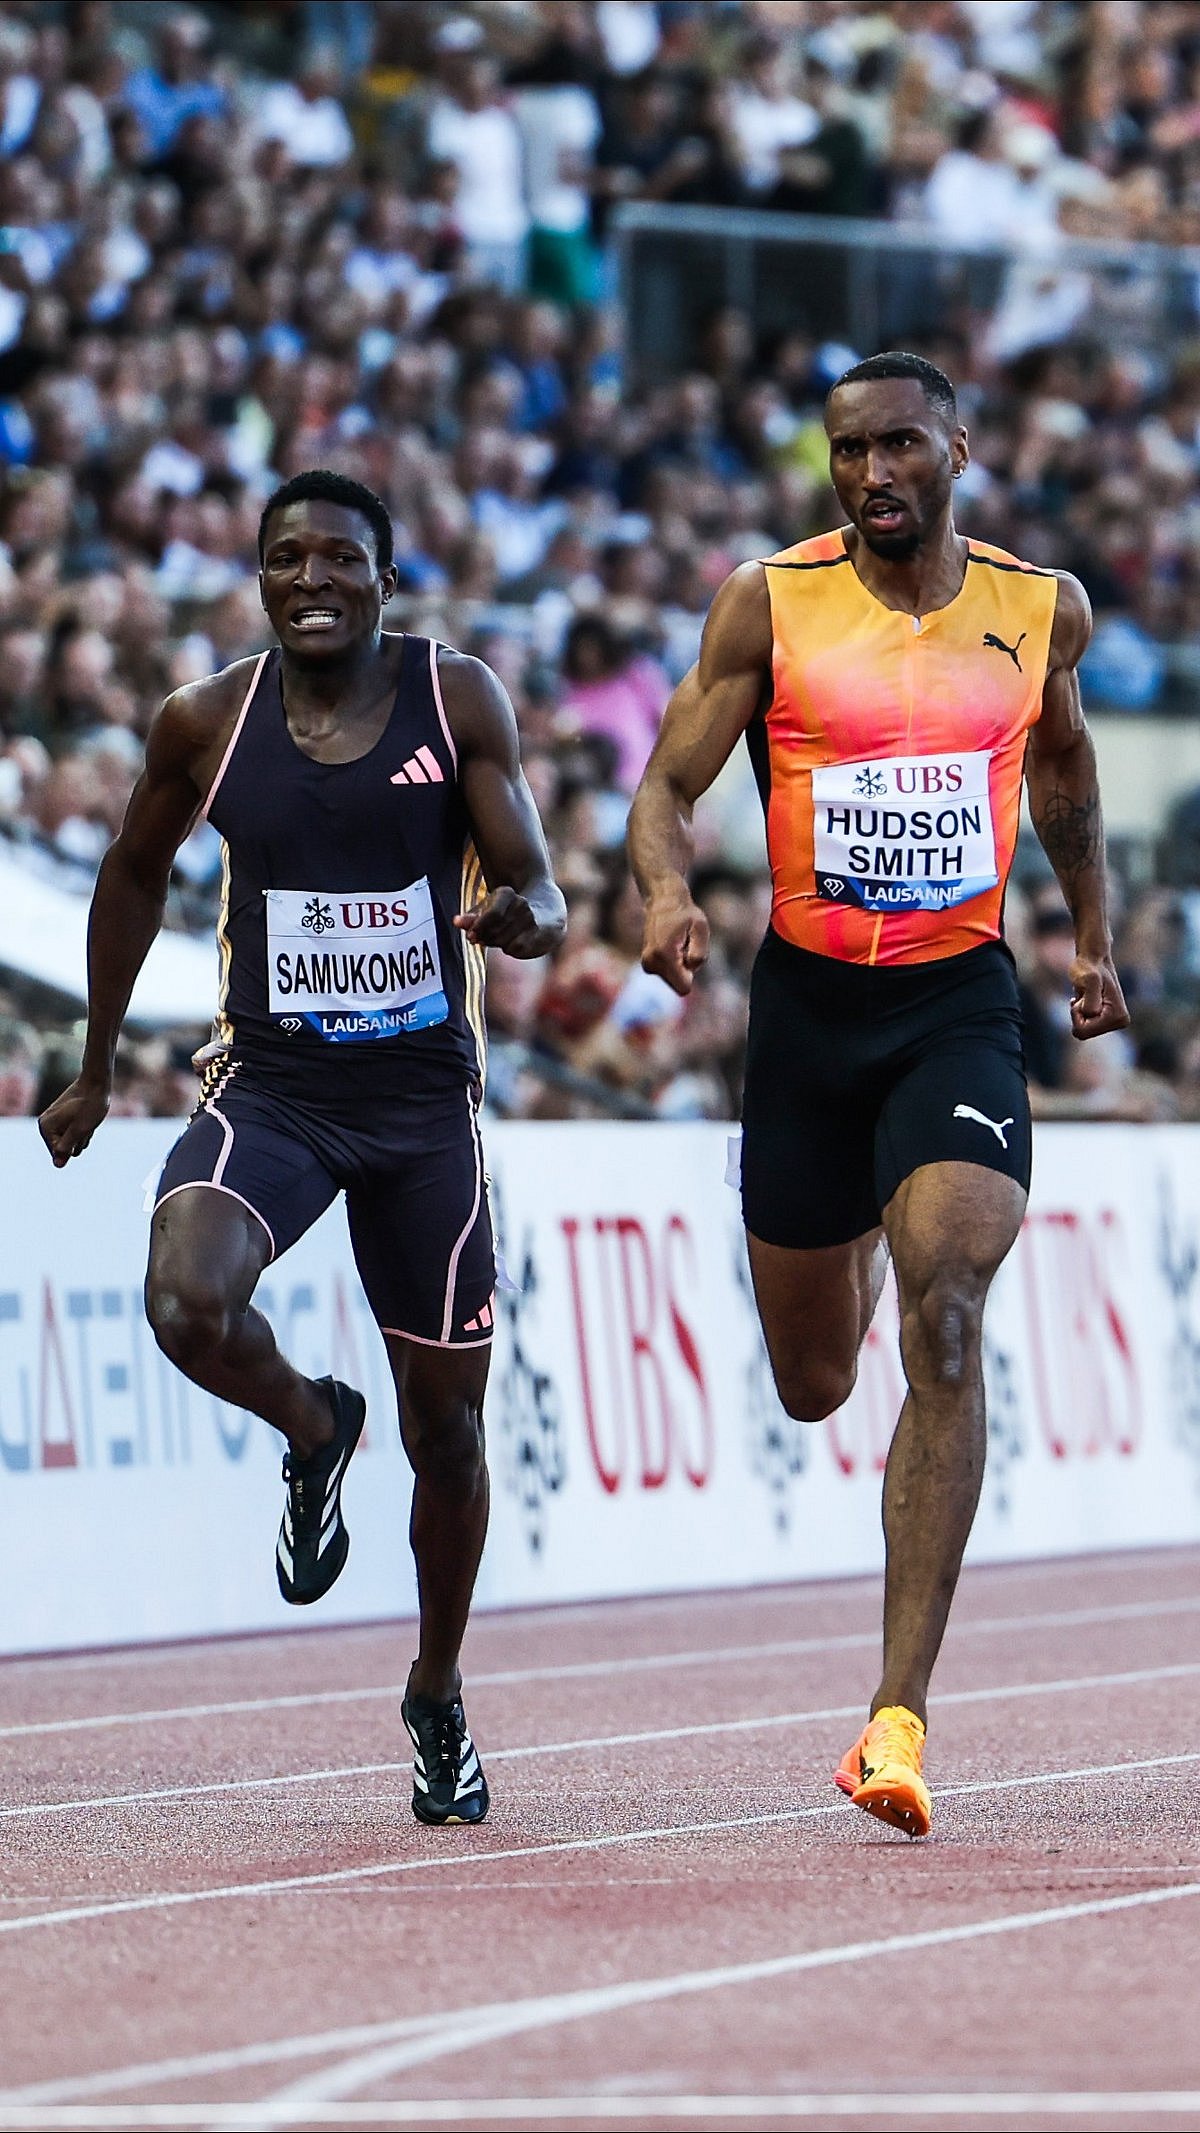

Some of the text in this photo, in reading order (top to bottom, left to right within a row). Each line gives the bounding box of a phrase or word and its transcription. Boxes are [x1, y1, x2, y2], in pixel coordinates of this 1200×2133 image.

[893, 764, 963, 794] UBS
[826, 805, 982, 840] HUDSON
[848, 845, 963, 876] SMITH
[864, 885, 963, 903] LAUSANNE
[340, 900, 409, 929] UBS
[276, 939, 436, 995] SAMUKONGA
[322, 1008, 418, 1034] LAUSANNE
[559, 1213, 714, 1495] UBS
